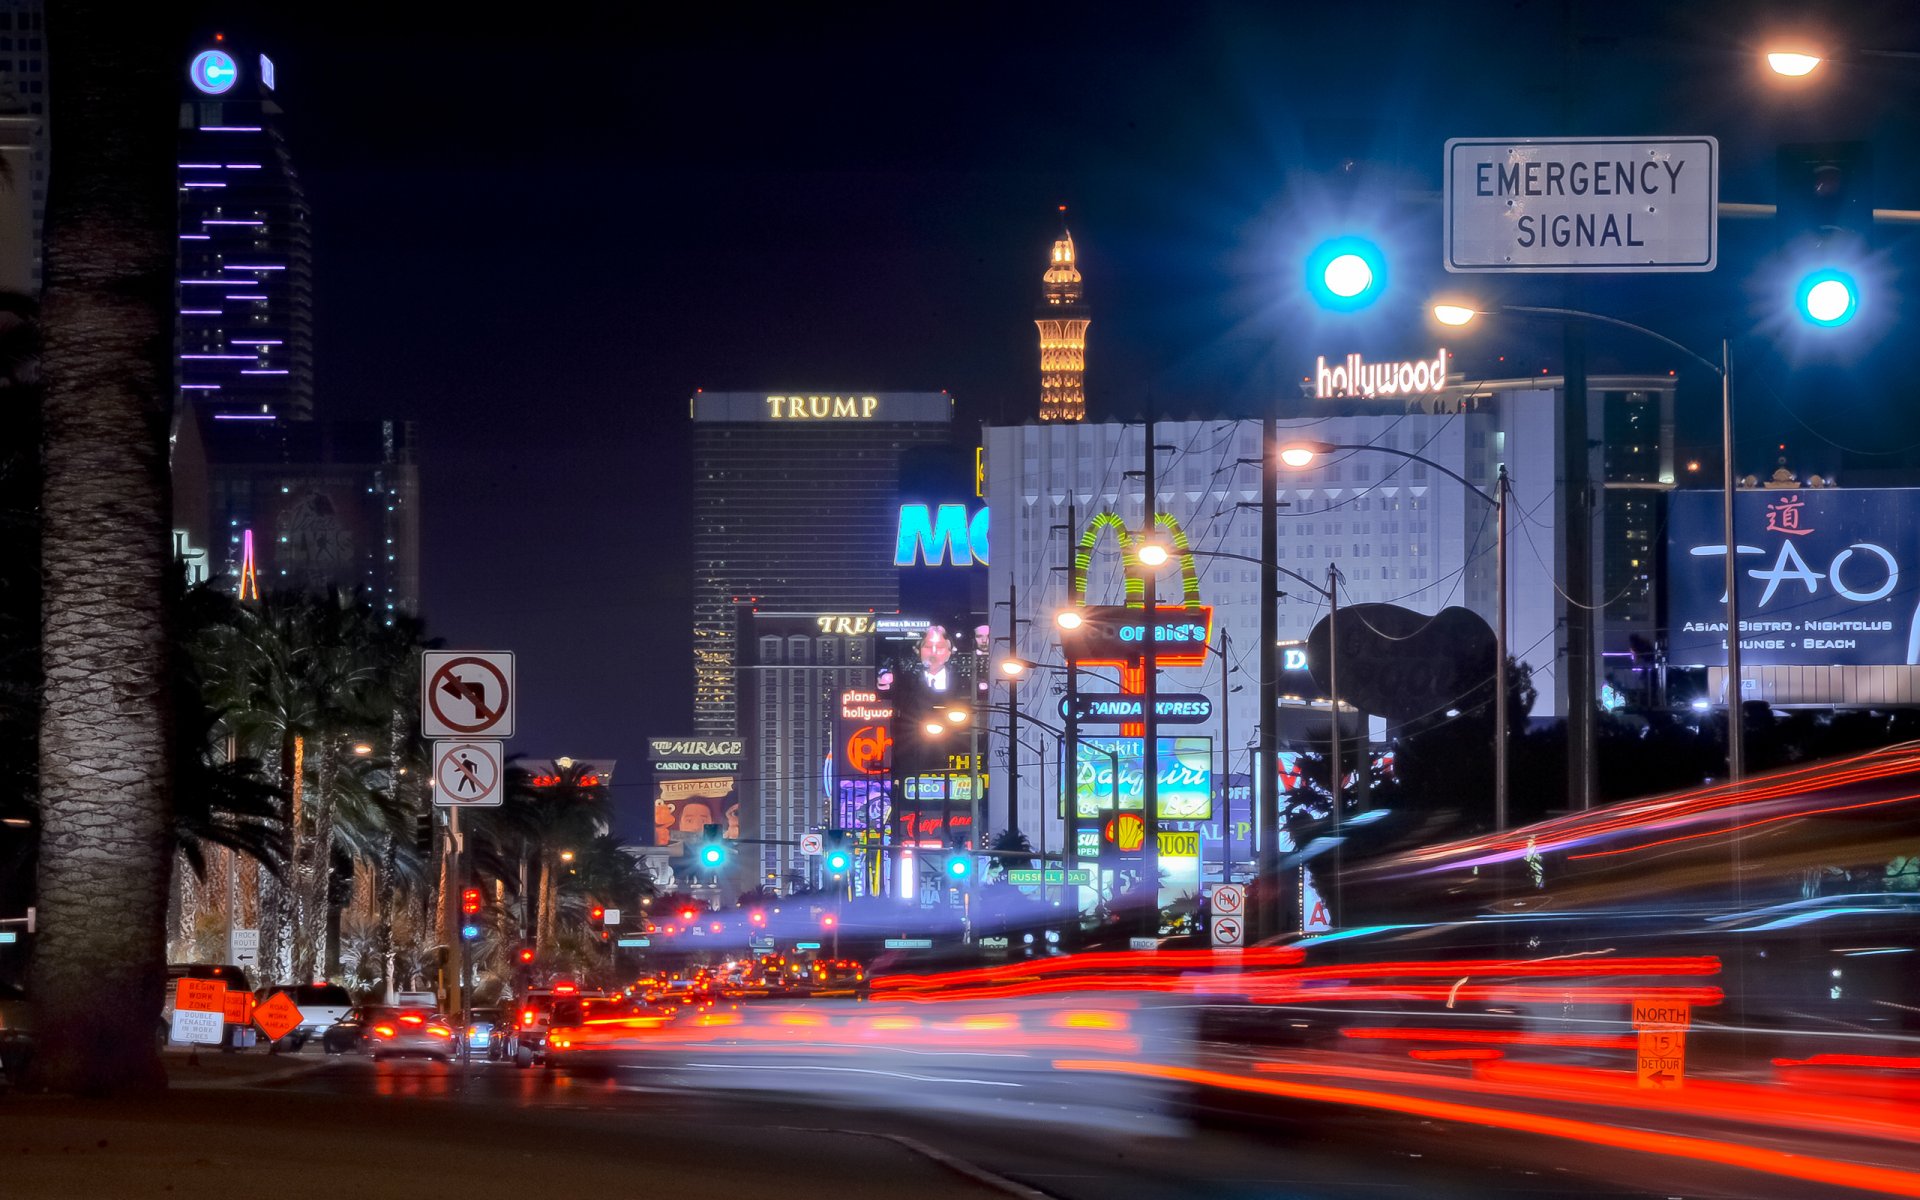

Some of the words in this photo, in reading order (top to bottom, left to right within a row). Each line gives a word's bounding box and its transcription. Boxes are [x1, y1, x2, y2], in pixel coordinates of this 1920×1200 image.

[1476, 160, 1685, 196] EMERGENCY
[1517, 213, 1644, 247] SIGNAL
[1316, 348, 1447, 398] hollywood
[766, 396, 878, 419] TRUMP
[1766, 495, 1815, 536] 道
[1690, 539, 1899, 608] TAO
[1683, 622, 1728, 632] ASIAN
[1739, 621, 1792, 631] BISTRO
[1804, 620, 1893, 631] NIGHTCLUB
[1722, 639, 1785, 649] LUNGE
[1803, 639, 1856, 649] BEACH
[1155, 702, 1210, 715] XPRESS
[672, 741, 742, 756] MIRAGE
[1083, 740, 1145, 757] Chakit
[665, 784, 695, 792] TERRY
[698, 781, 729, 789] FATOR
[908, 783, 939, 792] ARCO
[1010, 873, 1057, 881] RUSSELL
[189, 983, 215, 991] BEGIN
[1636, 1008, 1686, 1022] NORTH
[1653, 1037, 1669, 1050] 15
[1641, 1059, 1680, 1070] DETOUR
